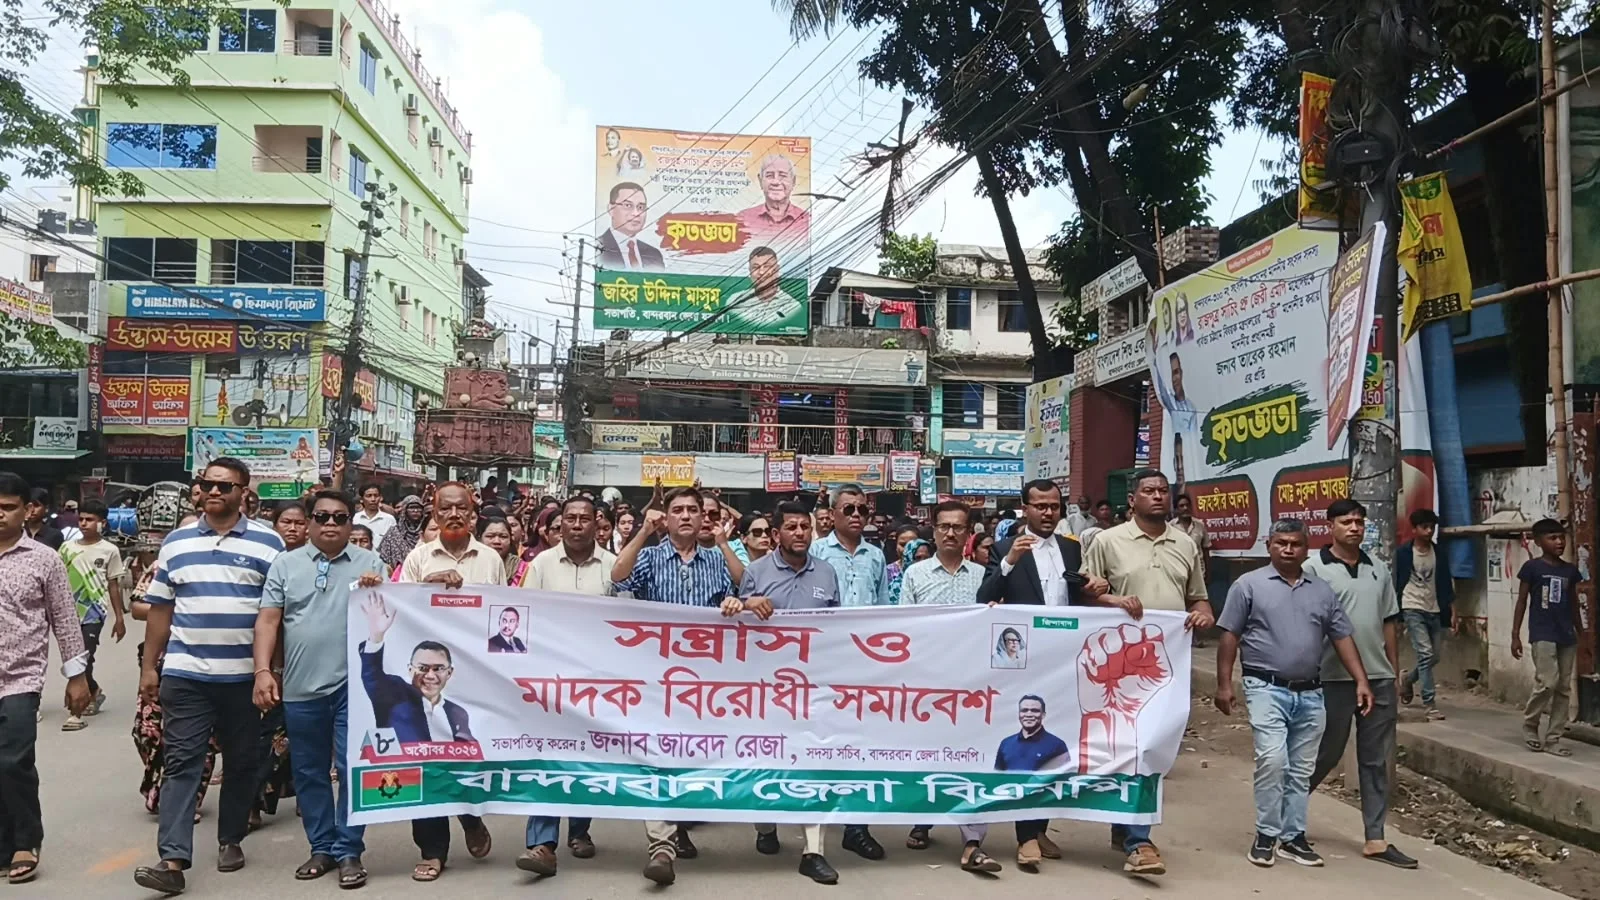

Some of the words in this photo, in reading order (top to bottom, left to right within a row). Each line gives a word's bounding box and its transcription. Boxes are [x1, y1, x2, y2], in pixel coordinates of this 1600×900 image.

[666, 220, 737, 249] কৃতজ্ঞতা
[602, 277, 640, 304] জহির
[642, 278, 682, 306] উদ্দিন
[144, 297, 188, 308] HIMALAYA
[604, 307, 640, 320] সভাপতি,
[642, 310, 678, 320] বান্দরবান
[110, 320, 234, 350] উদ্ভাস-উন্মেষ
[1134, 338, 1146, 353] এক
[672, 348, 789, 369] Raymond
[1216, 357, 1236, 376] জনাব
[1238, 346, 1266, 368] তারেক
[1268, 336, 1297, 359] রহমান
[712, 370, 740, 378] Tailors
[752, 371, 788, 380] Fashion
[105, 377, 144, 396] উদ্ভাস
[148, 378, 189, 397] উন্মেষ
[107, 396, 138, 408] অফিস
[152, 398, 184, 410] অফিস
[1210, 394, 1298, 462] কৃতজ্ঞতা
[968, 462, 1020, 472] পপুলার
[1277, 484, 1294, 503] মোঃ
[1320, 476, 1349, 500] আবছা
[1228, 490, 1250, 509] আলম
[438, 596, 476, 606] বাংলাদেশ
[1040, 618, 1073, 628] জিন্দাবাদ
[603, 620, 824, 664] সন্ত্রাস
[850, 632, 911, 664] ও
[513, 674, 648, 718] মাদক
[657, 666, 819, 720] বিরোধী
[829, 683, 1002, 726] সমাবেশ
[375, 732, 395, 754] ৮
[404, 742, 446, 757] অক্টোবর
[448, 744, 478, 757] ২০২৬
[492, 734, 544, 752] সভাপতিত্ব
[547, 738, 577, 750] করেন
[587, 730, 651, 756] জনাব
[656, 731, 729, 759] জাবেদ
[806, 747, 834, 761] সদস্য
[836, 744, 866, 763] সচিব,
[868, 747, 912, 762] বান্দরবান
[915, 748, 940, 762] জেলা
[942, 746, 986, 763] বিএনপি।
[448, 768, 740, 800] বান্দরবান
[752, 778, 904, 803] জেলা
[916, 774, 1137, 804] বিএনপি
